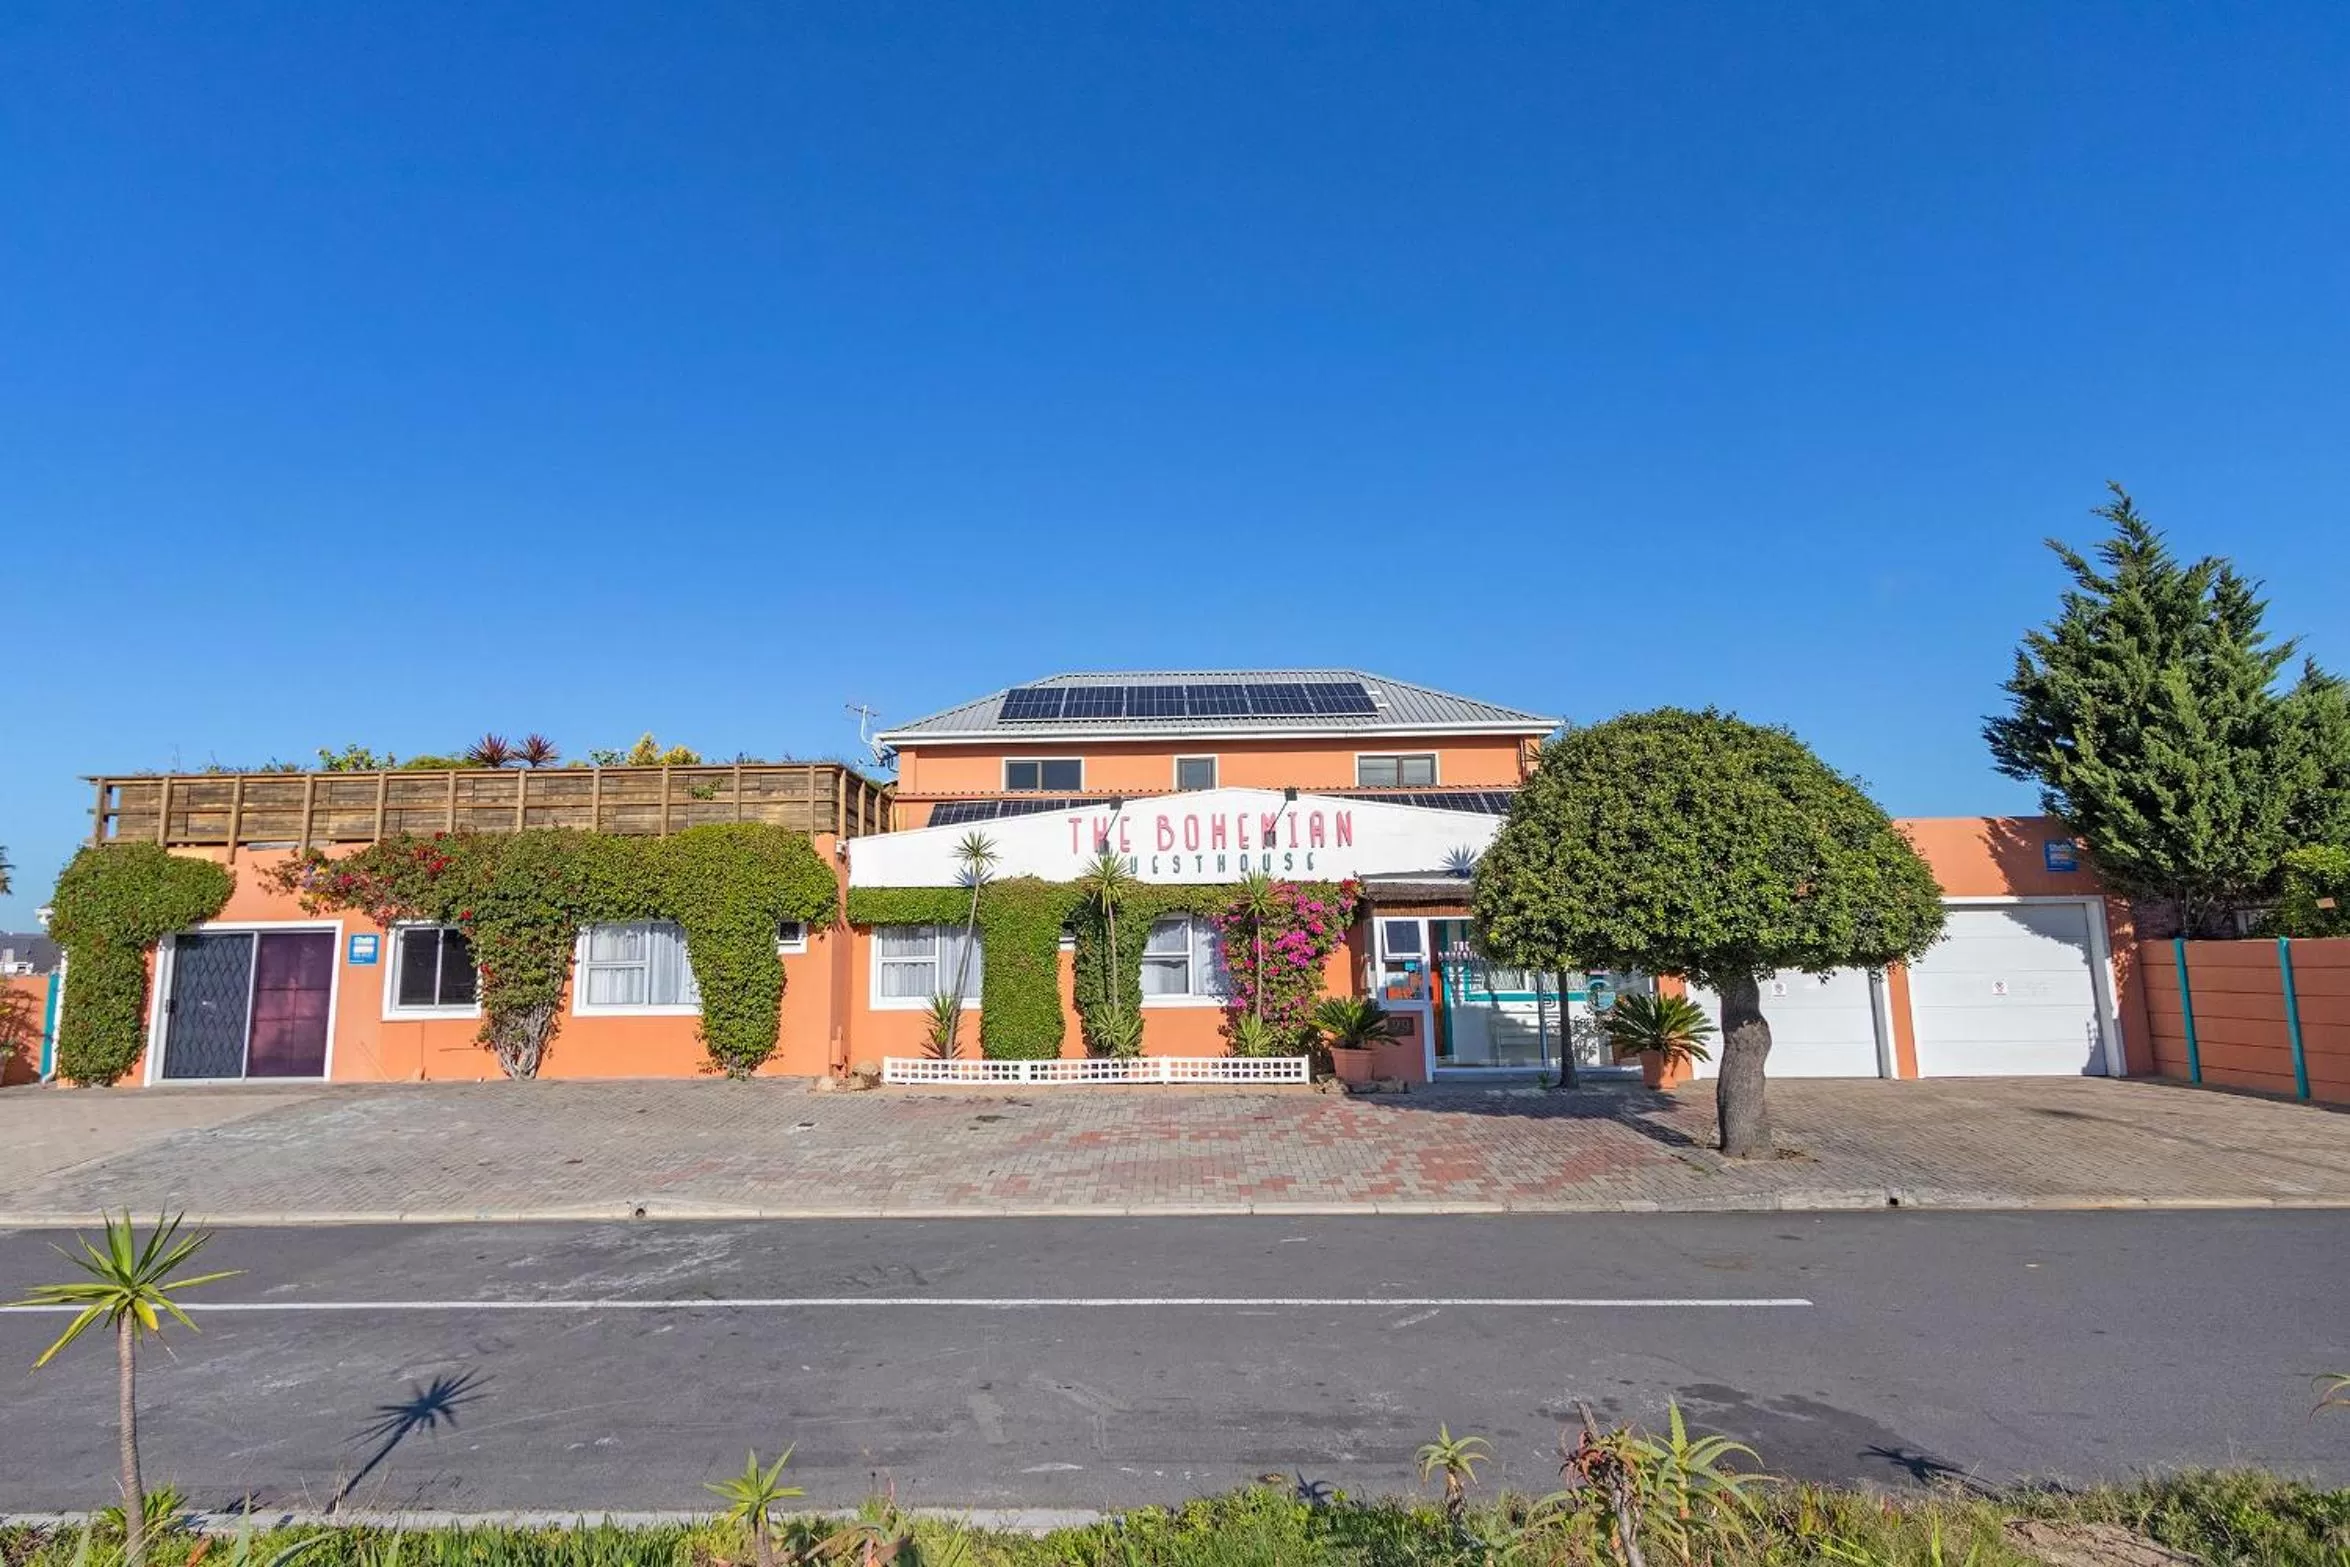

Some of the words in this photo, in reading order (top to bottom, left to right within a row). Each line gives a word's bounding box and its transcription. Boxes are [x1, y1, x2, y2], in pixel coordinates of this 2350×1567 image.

[1068, 815, 1131, 855] THE
[1156, 810, 1353, 852] BOHEMIAN
[1127, 852, 1314, 874] UESTHOUSE
